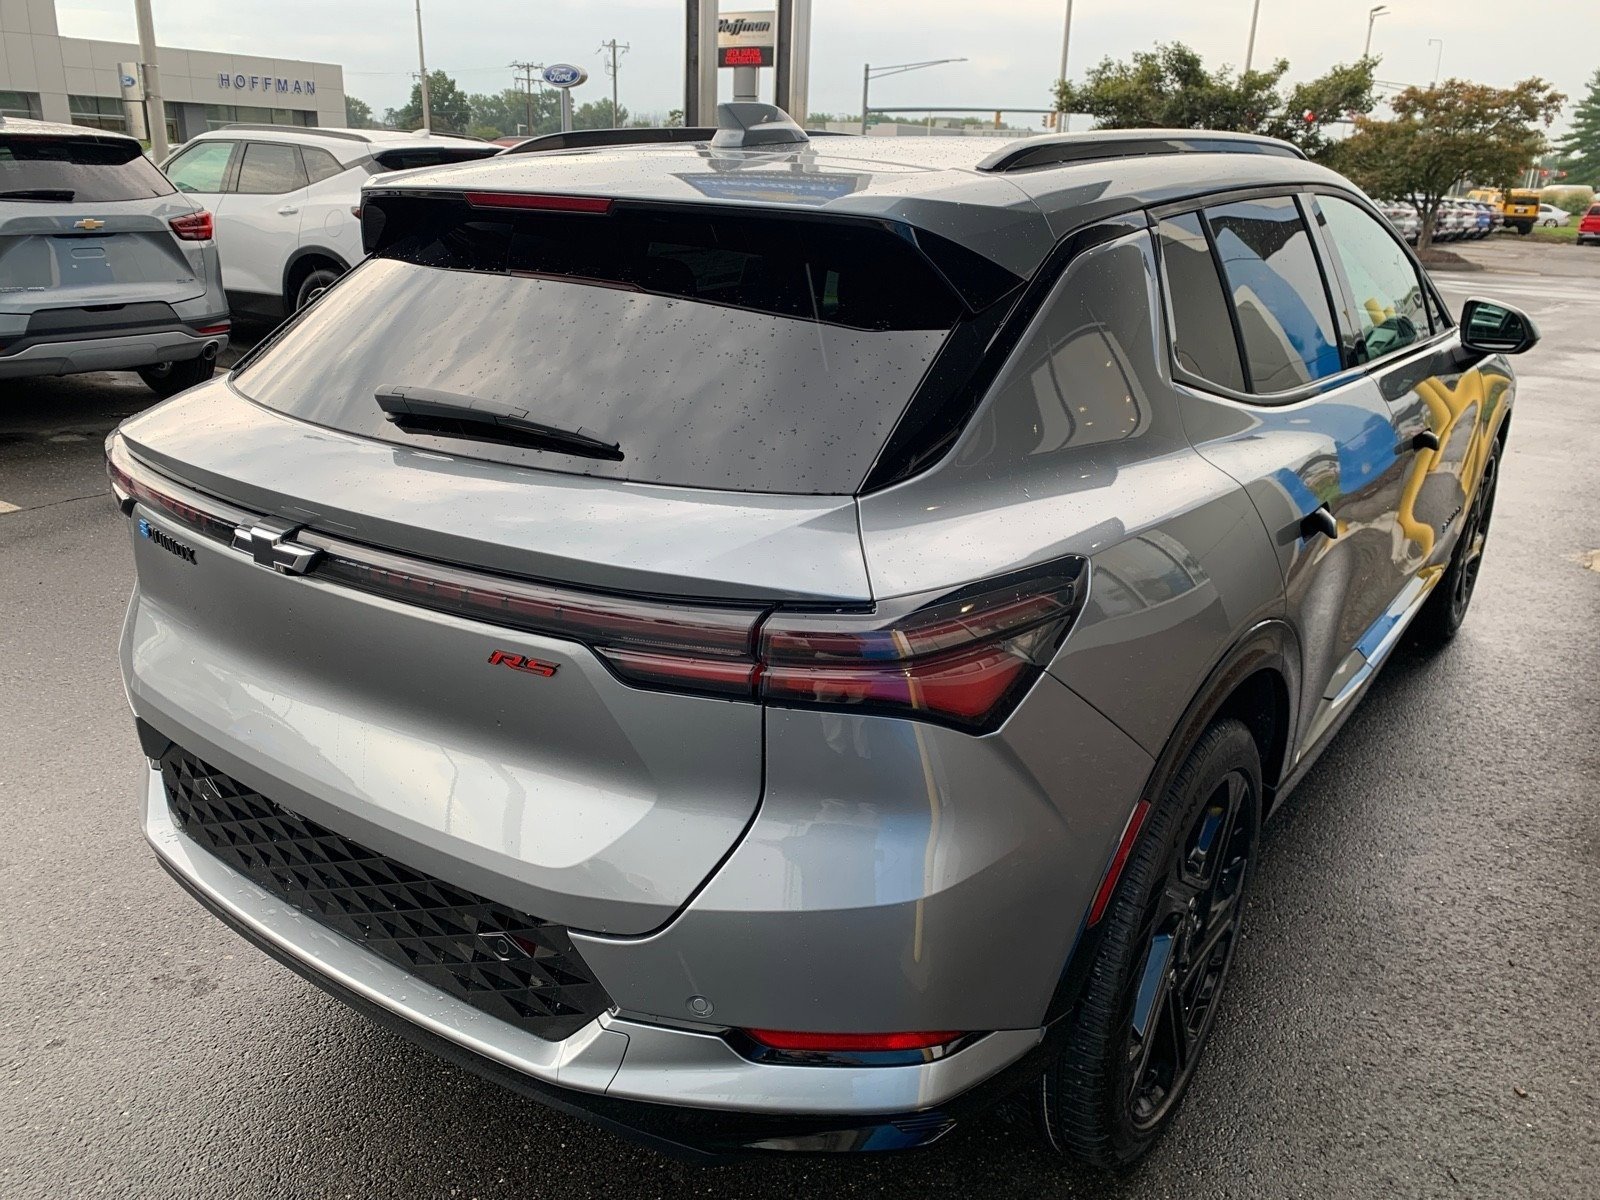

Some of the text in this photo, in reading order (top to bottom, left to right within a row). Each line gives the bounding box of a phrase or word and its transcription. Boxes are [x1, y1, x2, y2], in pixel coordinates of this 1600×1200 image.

[718, 18, 771, 36] Hoffman
[725, 56, 762, 65] CONSTRUCTION
[726, 48, 761, 57] OPEN DURING
[549, 67, 573, 82] Ford
[218, 73, 316, 95] HOFFMAN
[487, 649, 561, 678] RS
